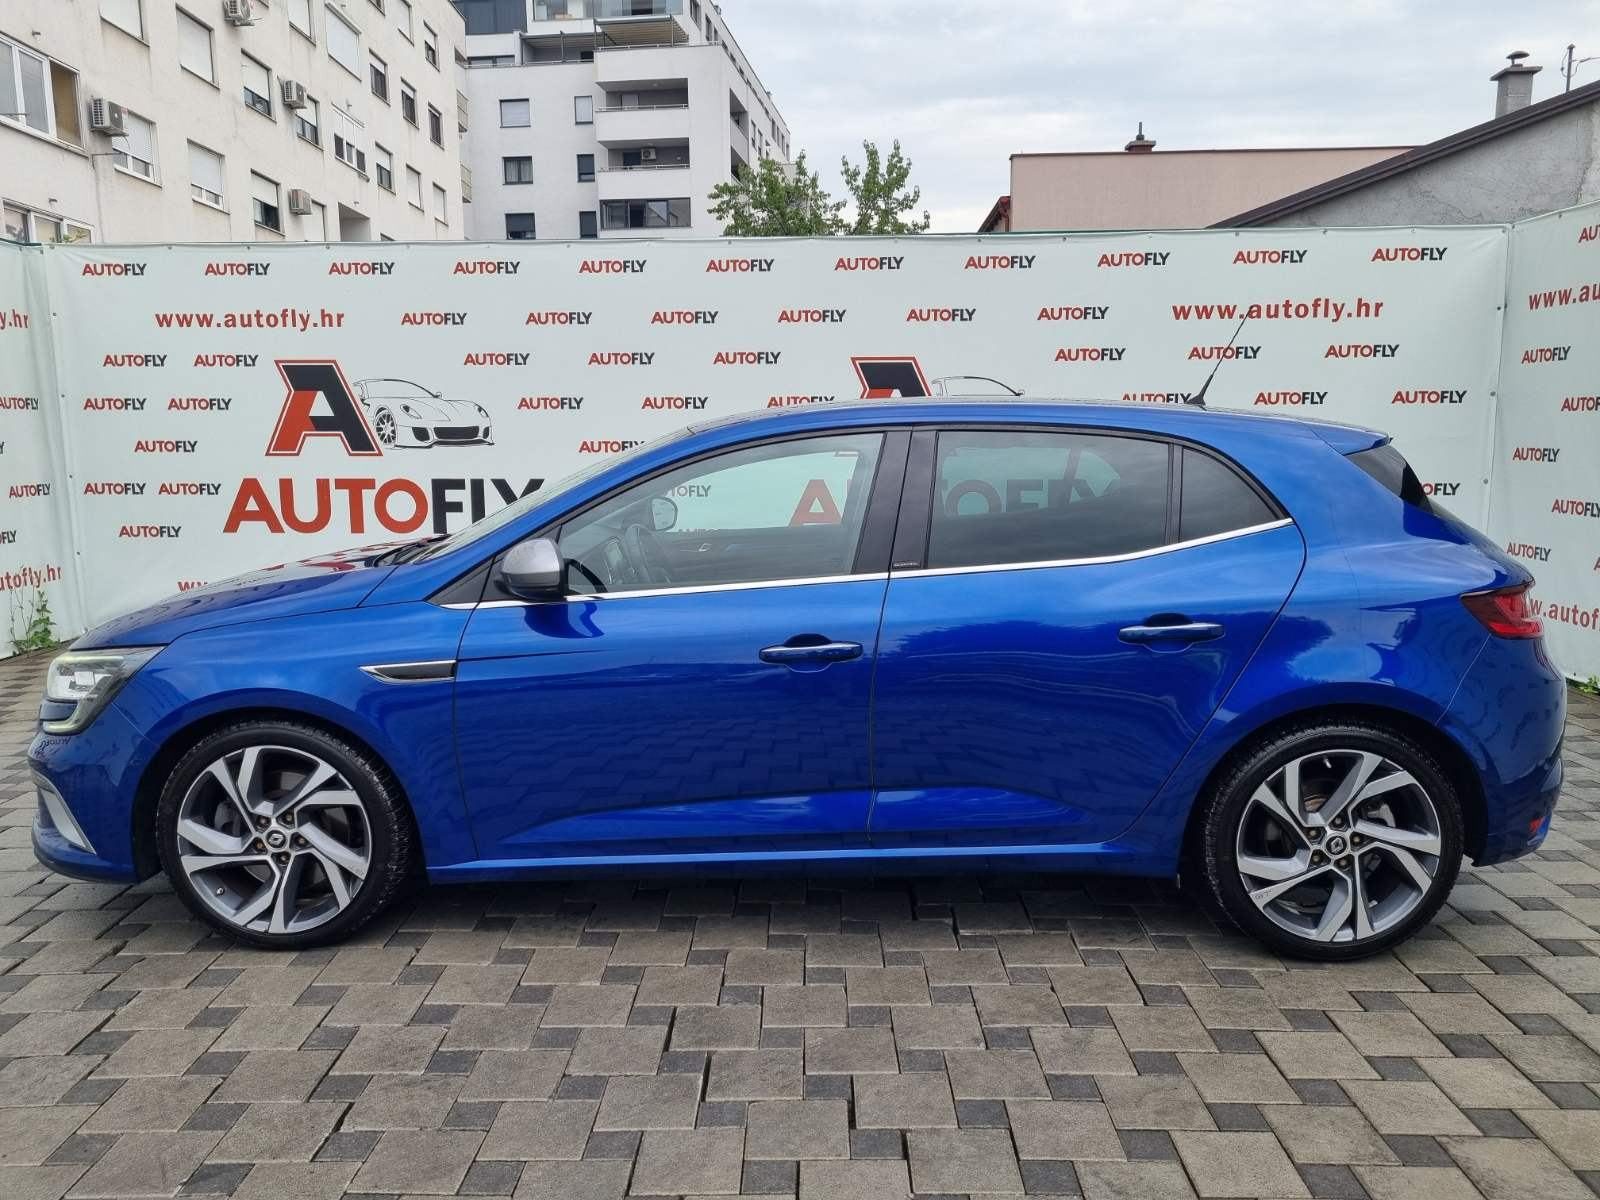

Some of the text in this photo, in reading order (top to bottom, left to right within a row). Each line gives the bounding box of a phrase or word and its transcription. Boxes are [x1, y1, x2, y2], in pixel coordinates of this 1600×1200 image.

[964, 255, 1037, 270] AUTOFLY
[1096, 251, 1171, 268] AUTOFLY
[1232, 249, 1308, 265] AUTOFLY
[1370, 247, 1448, 263] AUTOFLY
[81, 262, 148, 277] AUTOFLY
[204, 262, 271, 277] AUTOFLY
[328, 261, 396, 276] AUTOFLY
[452, 260, 521, 275] AUTOFLY
[578, 259, 648, 274] AUTOFLY
[705, 258, 775, 273] AUTOFLY
[833, 256, 905, 271] AUTOFLY
[650, 310, 719, 325] AUTOFLY
[777, 308, 847, 324] AUTOFLY
[905, 307, 977, 322] AUTOFLY
[1036, 306, 1110, 321] AUTOFLY
[1172, 297, 1384, 323] www.autofly.hr
[154, 308, 345, 333] www.autofly.hr
[400, 312, 468, 326] AUTOFLY
[525, 311, 593, 326] AUTOFLY
[587, 351, 656, 366] AUTOFLY
[712, 351, 782, 365] AUTOFLY
[1054, 347, 1127, 362] AUTOFLY
[1187, 345, 1263, 361] AUTOFLY
[1324, 343, 1400, 359] AUTOFLY
[1520, 345, 1572, 365] AUTOFLY
[102, 353, 168, 368] AUTOFLY
[193, 353, 259, 368] AUTOFLY
[463, 352, 531, 366] AUTOFLY
[82, 397, 147, 411] AUTOFLY
[167, 397, 233, 411] AUTOFLY
[517, 396, 585, 411] AUTOFLY
[641, 396, 709, 410] AUTOFLY
[1253, 391, 1329, 406] AUTOFLY
[1391, 389, 1468, 405] AUTOFLY
[133, 439, 199, 453] AUTOFLY
[1512, 447, 1561, 463] AUTOFLY
[8, 483, 51, 499] AUTOFLY
[83, 482, 147, 496] AUTOFLY
[158, 482, 222, 496] AUTOFLY
[118, 525, 182, 538] AUTOFLY
[1506, 542, 1552, 562] AUTOFLY
